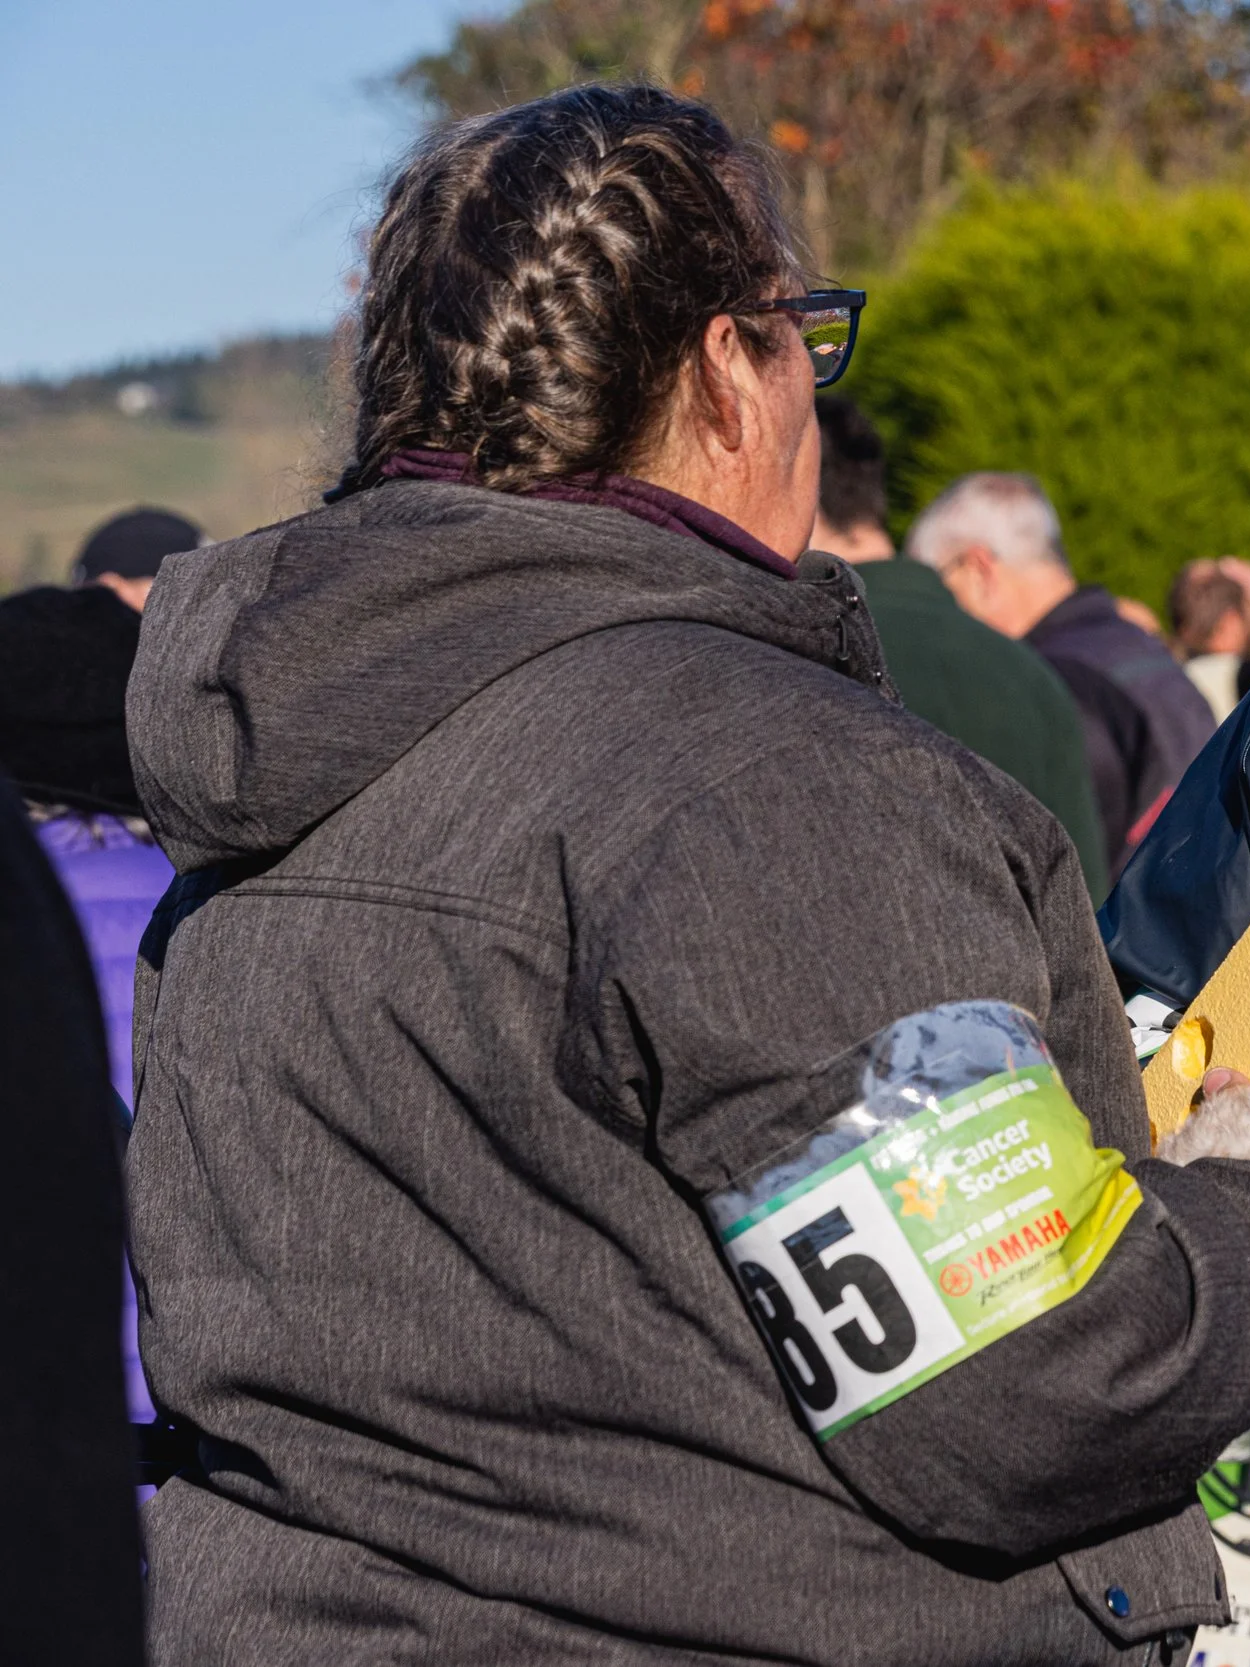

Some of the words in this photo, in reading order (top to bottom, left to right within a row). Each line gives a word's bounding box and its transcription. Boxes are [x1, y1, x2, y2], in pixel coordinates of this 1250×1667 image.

[947, 1119, 1030, 1175] Cancer
[956, 1141, 1053, 1201] Society
[966, 1207, 1072, 1280] YAMAHA
[737, 1205, 917, 1412] 85
